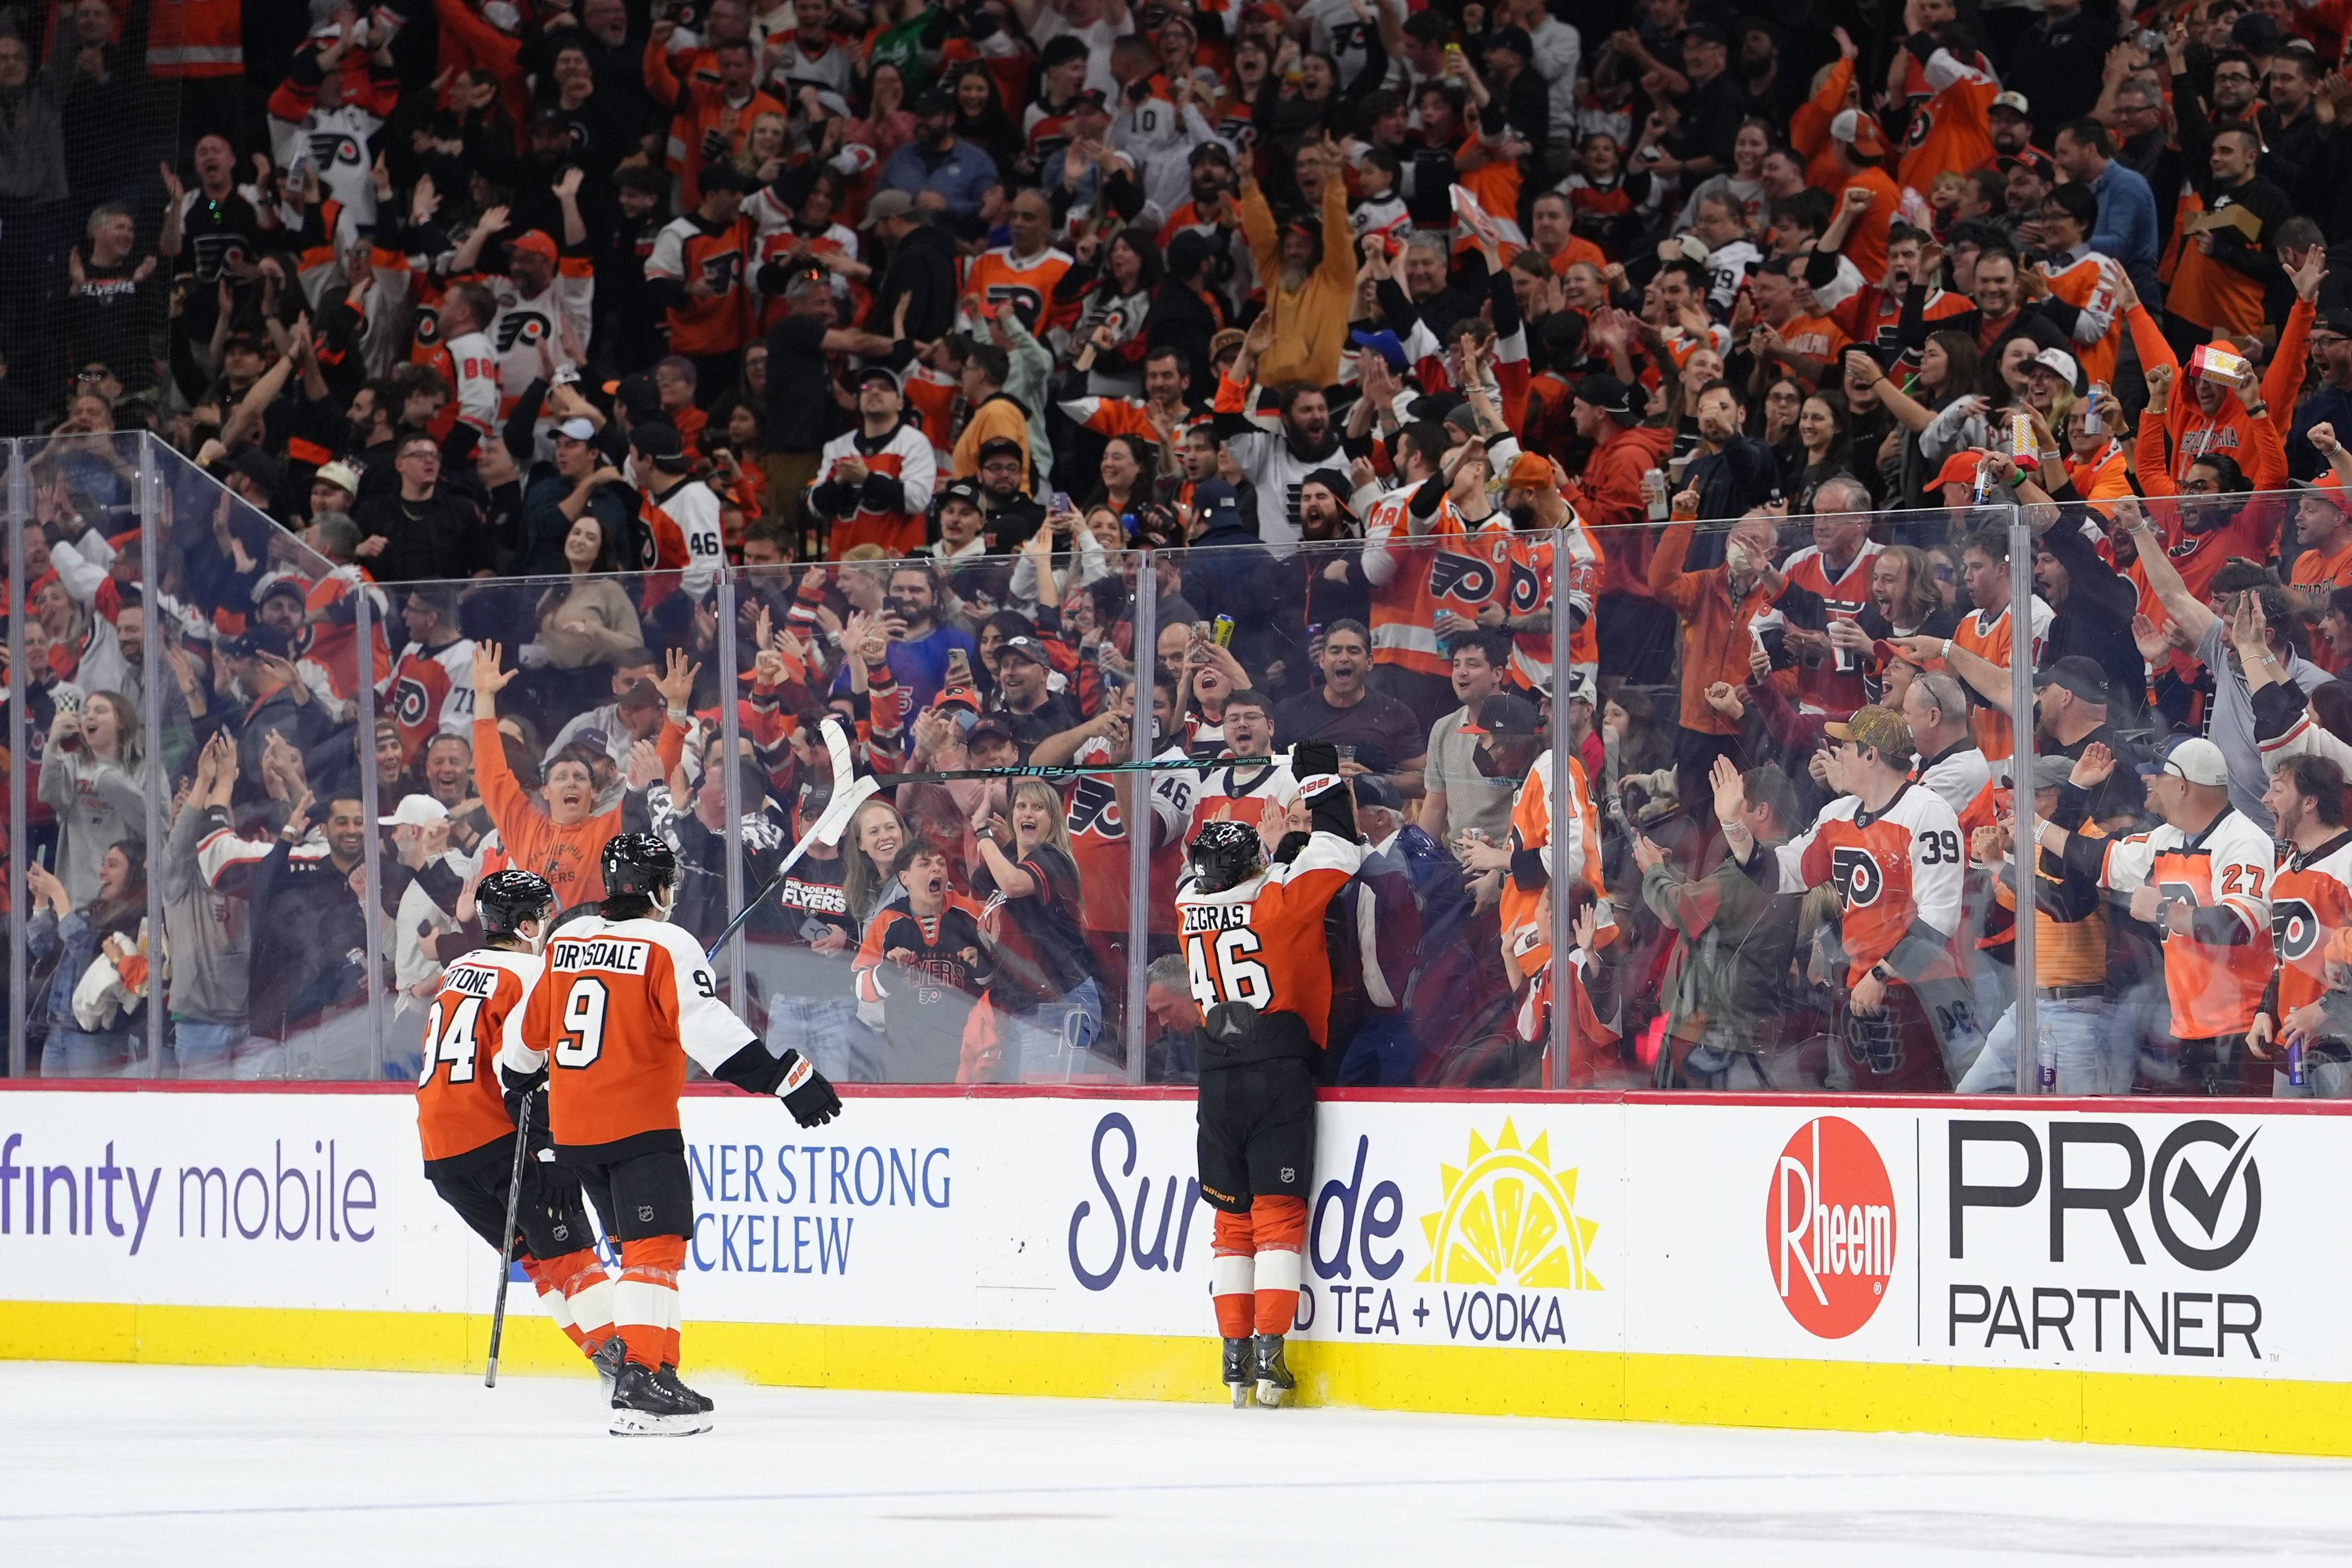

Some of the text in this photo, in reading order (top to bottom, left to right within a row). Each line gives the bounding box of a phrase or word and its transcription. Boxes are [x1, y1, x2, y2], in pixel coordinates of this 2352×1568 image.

[691, 532, 718, 555] 46
[453, 686, 475, 715] 71
[1157, 777, 1192, 812] 46
[1919, 830, 1960, 865] 39
[610, 859, 617, 872] 9
[1195, 864, 1205, 876] 46
[2221, 863, 2265, 899] 27
[782, 888, 846, 913] FLYERS
[786, 880, 844, 897] PHILADELPHI
[1185, 904, 1244, 931] ZEGRAS
[555, 942, 641, 970] DRYSDALE
[1185, 926, 1275, 1017] 46
[693, 970, 715, 998] 9
[555, 976, 609, 1070] 9
[180, 1140, 376, 1242] mobile
[777, 1144, 950, 1209] STRONG
[1202, 1184, 1235, 1203] BAUER
[1780, 1119, 1891, 1306] Rheem
[1949, 1119, 2262, 1271] PRO
[680, 1212, 854, 1275] CKELEW
[1330, 1285, 1399, 1336] TEA
[1443, 1290, 1566, 1344] VODKA
[1949, 1284, 2262, 1360] PARTNER
